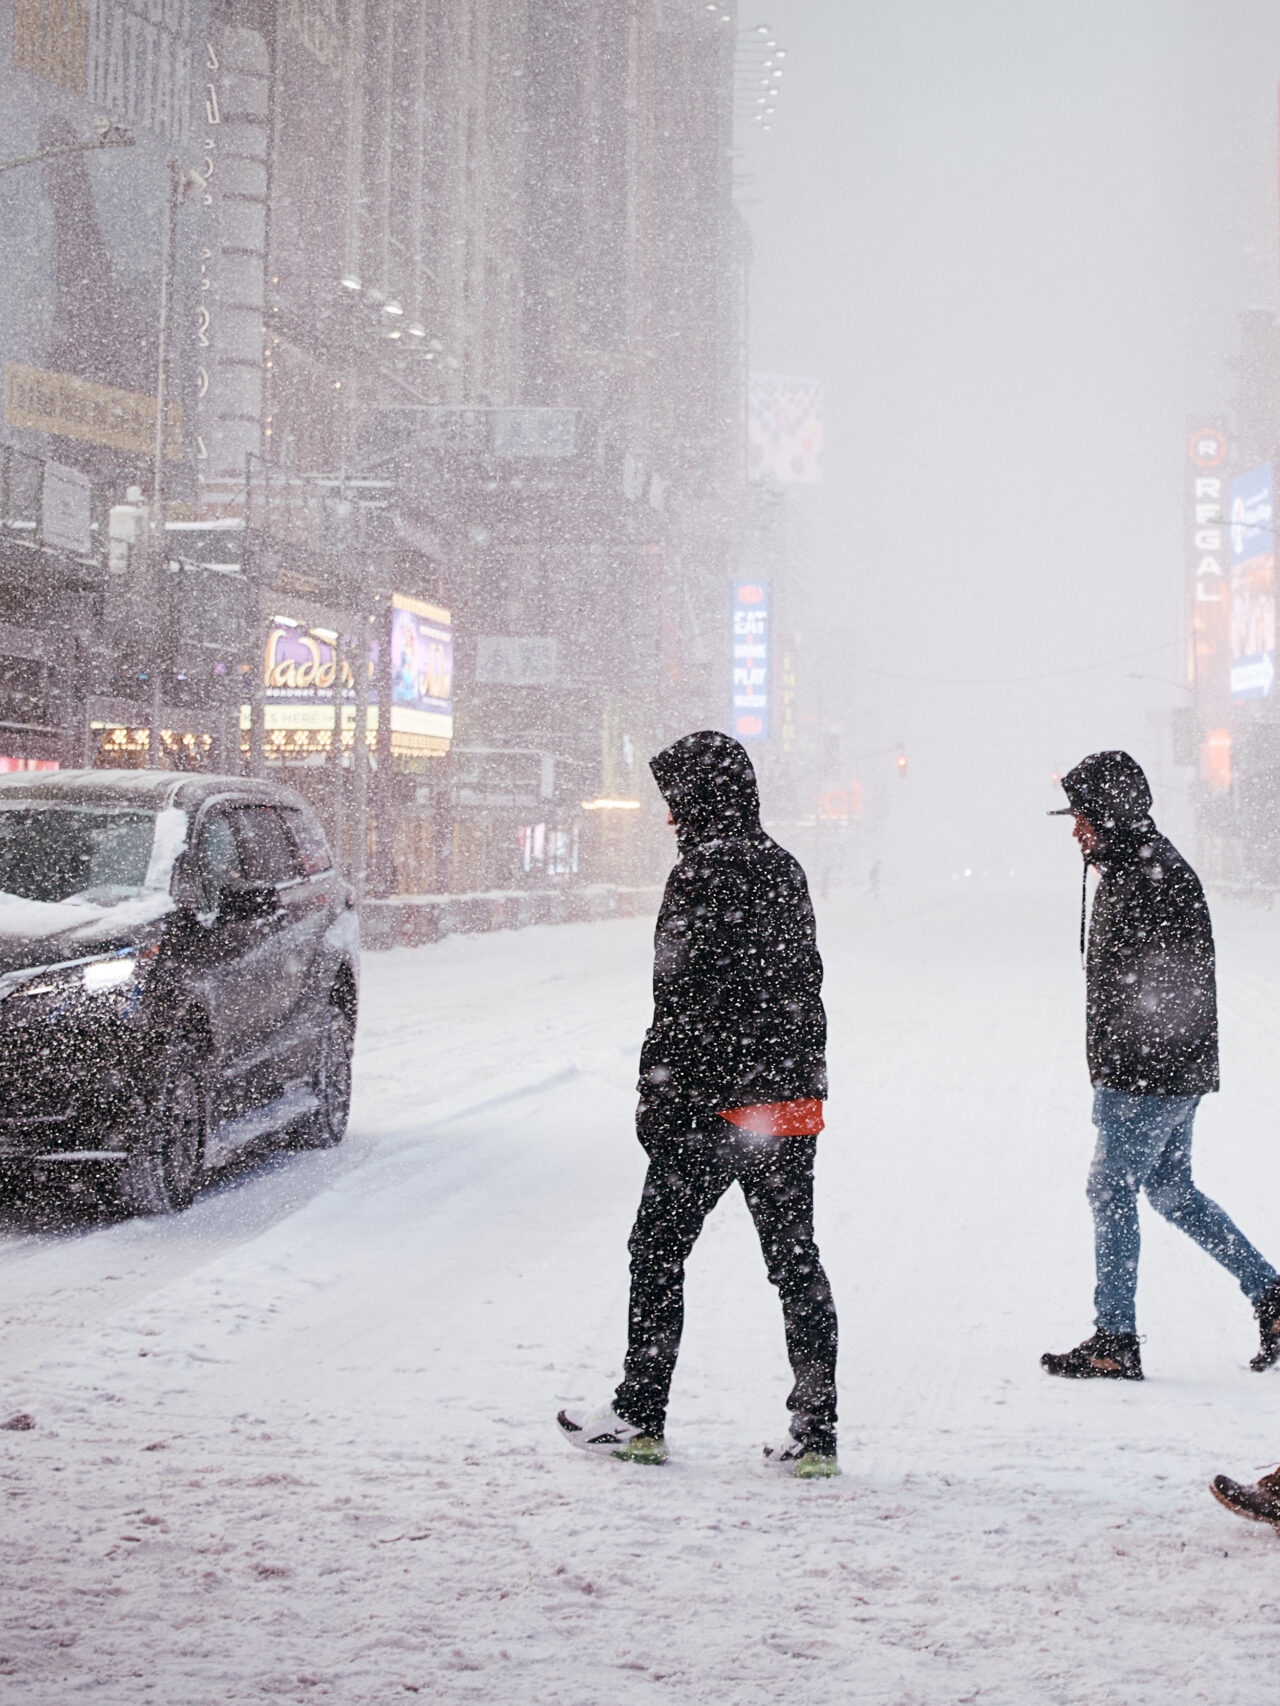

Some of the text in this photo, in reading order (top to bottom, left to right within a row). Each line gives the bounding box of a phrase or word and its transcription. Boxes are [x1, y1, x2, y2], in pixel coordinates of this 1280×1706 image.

[1195, 477, 1223, 601] REGAL
[733, 611, 767, 634] EAT
[733, 668, 766, 685] PLAY
